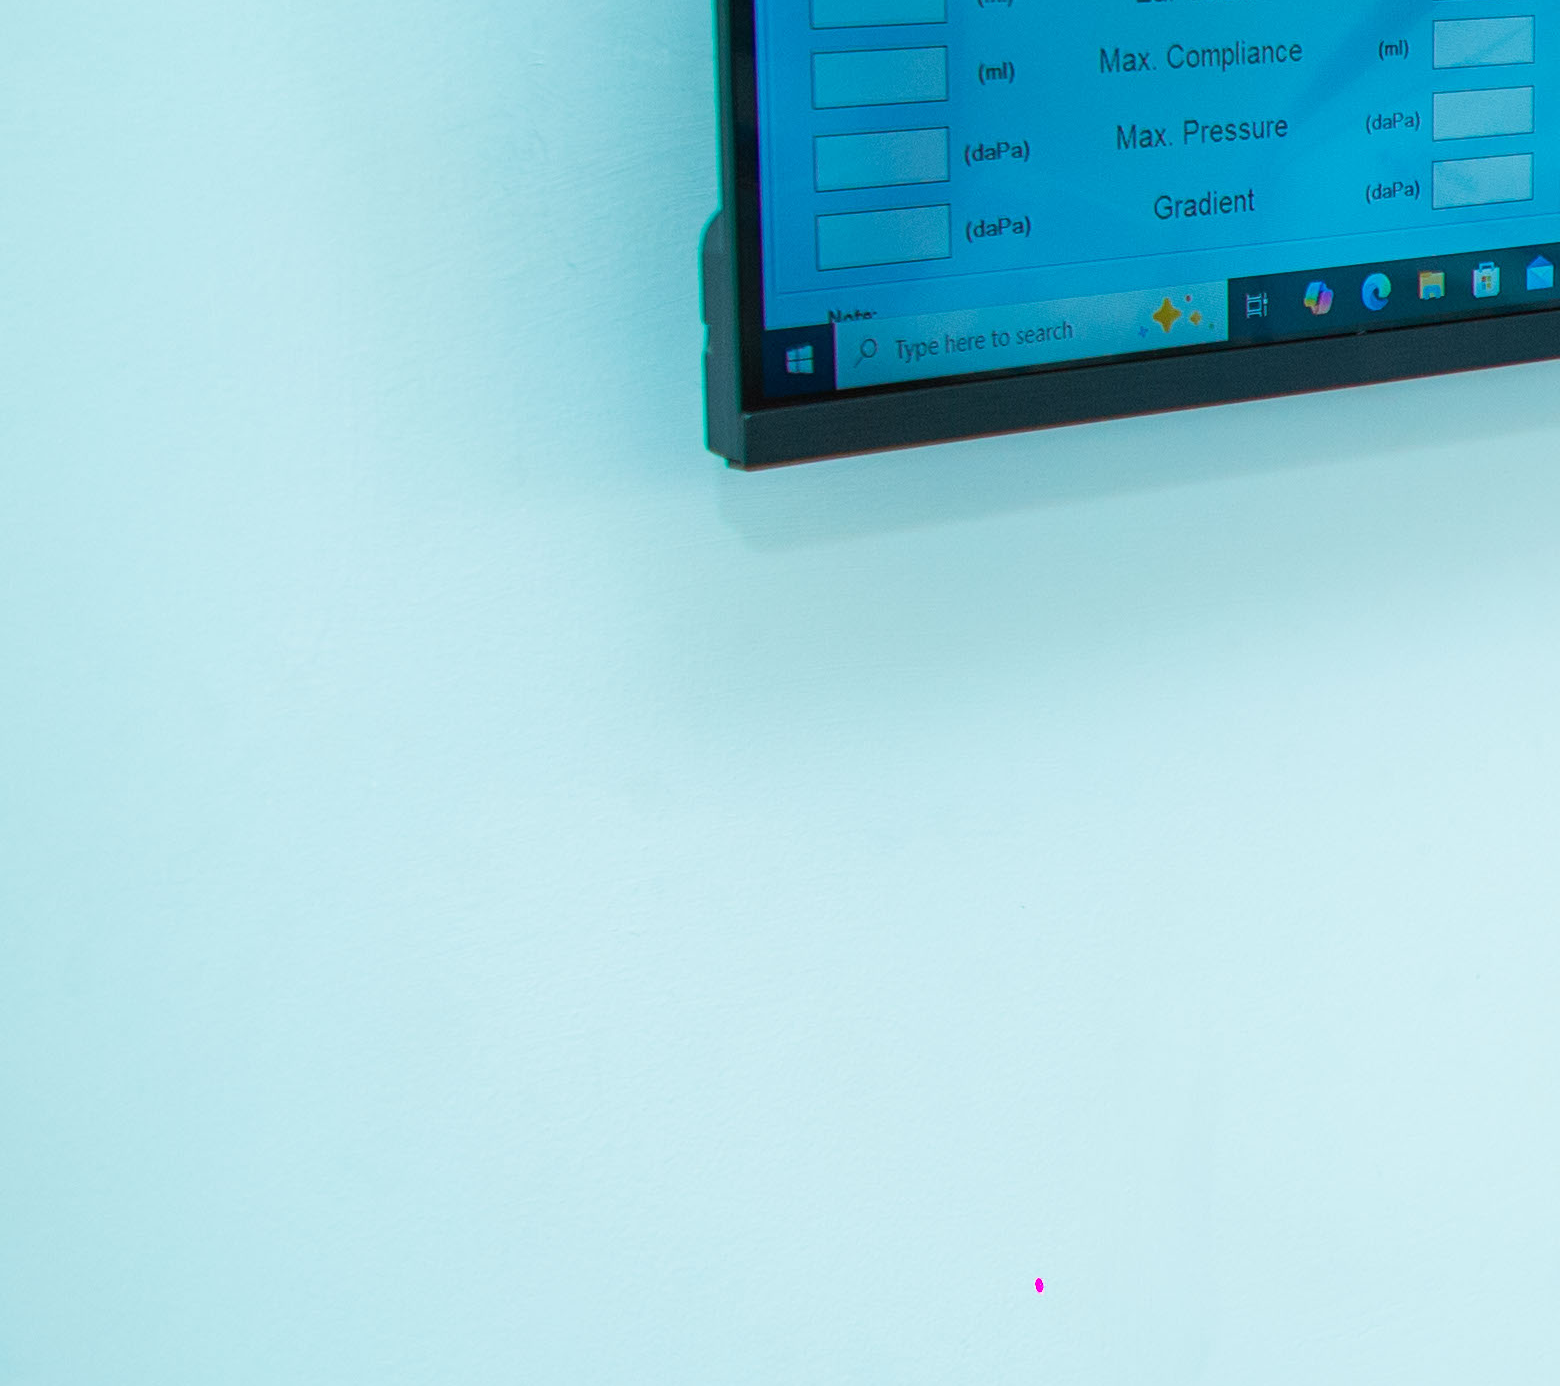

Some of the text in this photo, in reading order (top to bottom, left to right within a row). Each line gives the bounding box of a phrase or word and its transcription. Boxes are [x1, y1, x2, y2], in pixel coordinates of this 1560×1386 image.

[1099, 38, 1304, 75] Max. Compliance
[1377, 38, 1411, 60] (ml)
[977, 60, 1016, 86] (ml)
[1116, 116, 1290, 152] Max. Pressure
[1365, 111, 1421, 135] (daPa)
[963, 139, 1031, 168] (daPa)
[1152, 187, 1256, 221] Gradient
[1365, 180, 1421, 201] (daPa)
[964, 216, 1032, 243] (daPa)
[895, 320, 1074, 365] Type here to search
